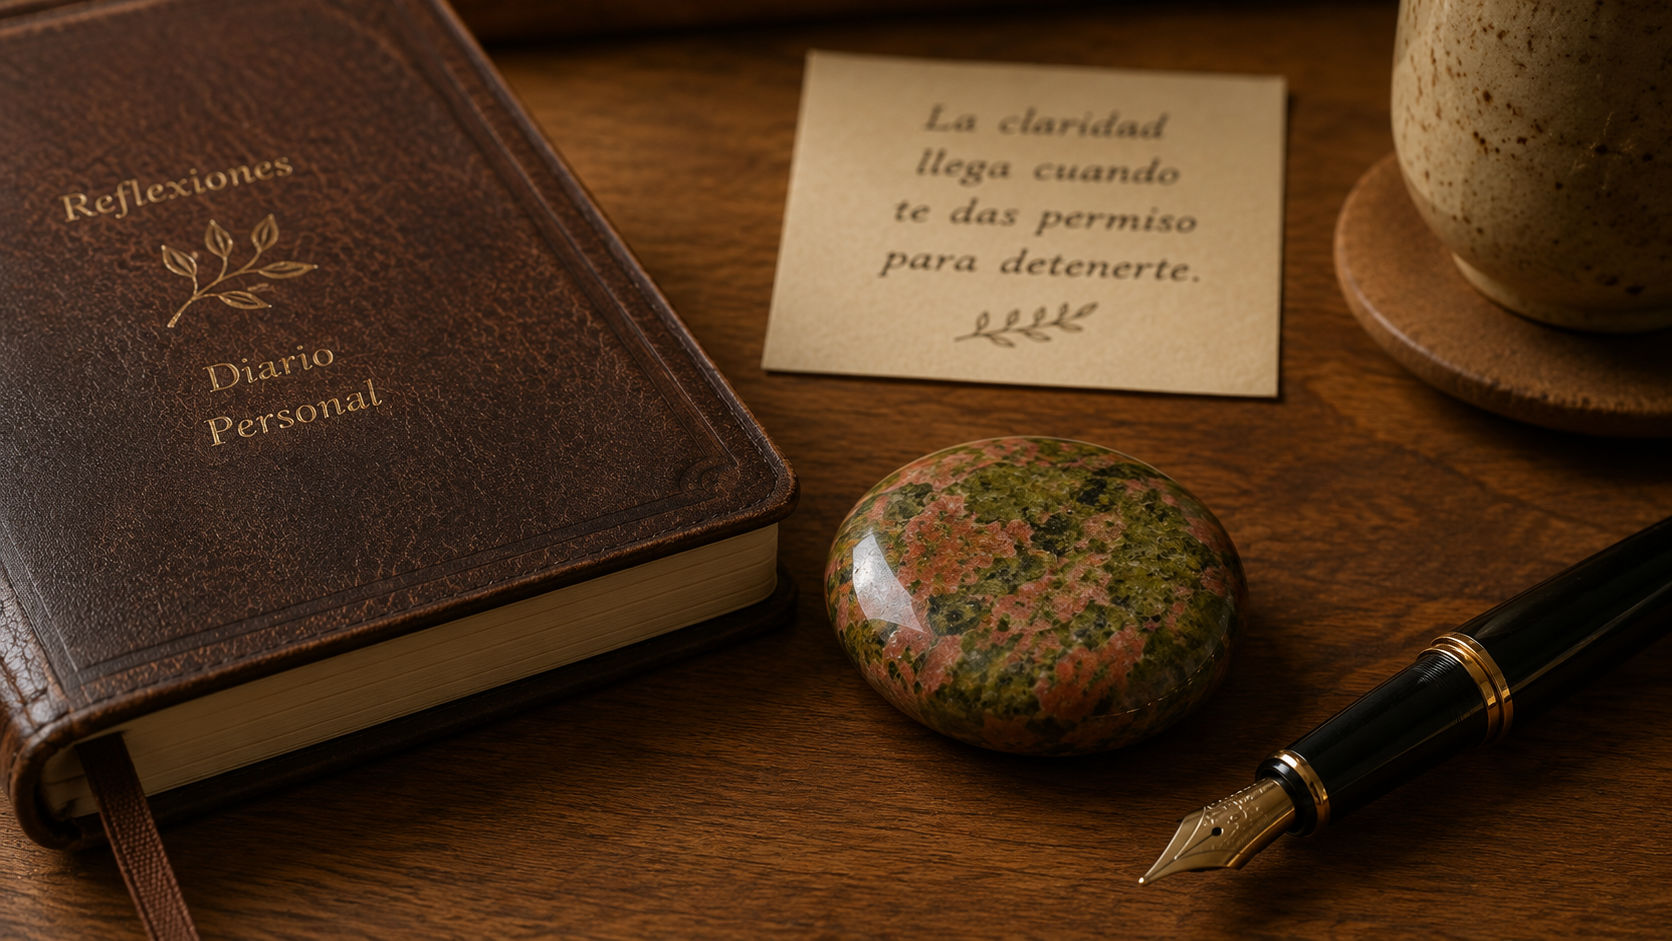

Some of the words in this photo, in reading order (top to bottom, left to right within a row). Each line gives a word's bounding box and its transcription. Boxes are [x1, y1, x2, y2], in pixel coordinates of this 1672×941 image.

[924, 103, 976, 133] La
[999, 106, 1170, 139] claridad
[916, 148, 1011, 187] llega
[1033, 156, 1181, 186] cuando
[63, 157, 293, 222] Reflexiones
[895, 200, 931, 223] te
[950, 197, 1019, 226] das
[1034, 207, 1198, 236] permiso
[878, 251, 977, 278] para
[1000, 248, 1200, 283] detenerte.
[202, 345, 334, 393] Diario
[204, 379, 383, 446] Personal
